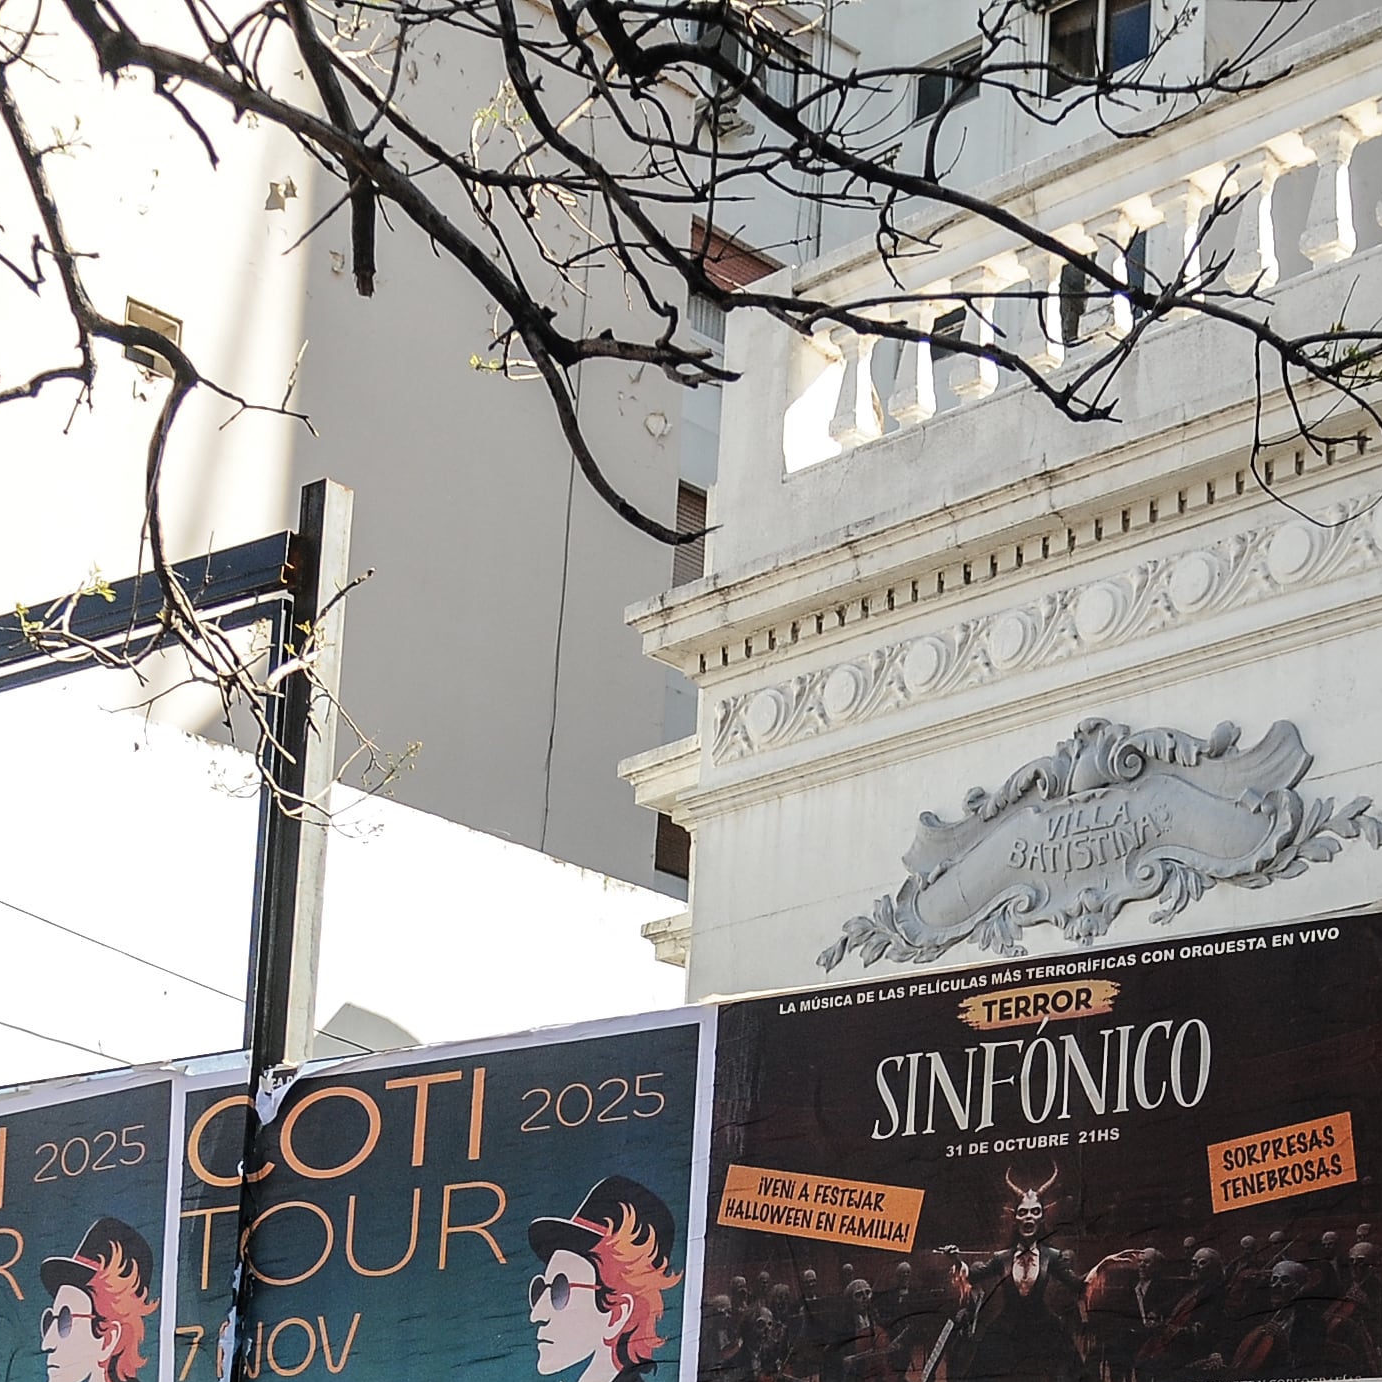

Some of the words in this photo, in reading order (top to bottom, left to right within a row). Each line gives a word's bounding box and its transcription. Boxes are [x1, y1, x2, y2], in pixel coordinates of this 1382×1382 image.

[1009, 813, 1161, 874] BATISTINA
[1045, 801, 1131, 842] VILLA
[982, 987, 1093, 1023] TERROR
[871, 1017, 1210, 1141] SINFÓNICO
[33, 1124, 146, 1184] 2025
[187, 1067, 486, 1187] COTI
[519, 1072, 666, 1133] 2025
[1222, 1125, 1336, 1172] SORPRESAS
[1220, 1153, 1343, 1202] TENEBROSAS
[180, 1181, 508, 1291] TOUR
